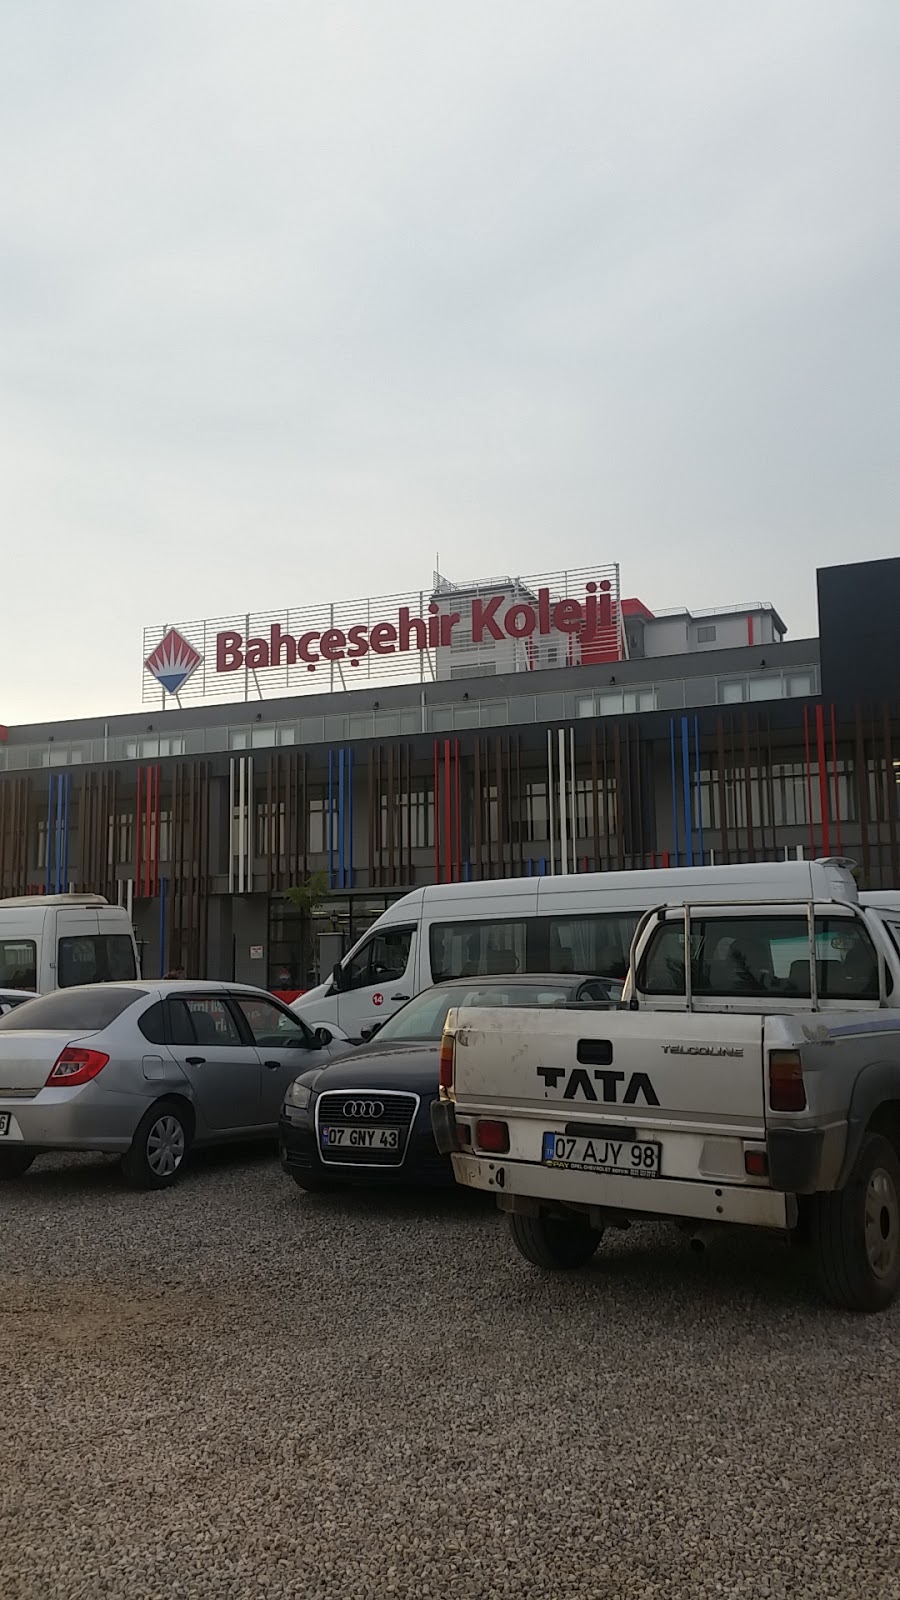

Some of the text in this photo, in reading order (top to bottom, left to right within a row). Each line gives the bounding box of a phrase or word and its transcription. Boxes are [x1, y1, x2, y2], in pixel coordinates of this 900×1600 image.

[216, 580, 612, 672] Bahçeşehir Koleji
[661, 1044, 744, 1058] TELCOLINE
[536, 1066, 661, 1107] TATA
[329, 1129, 345, 1145] 07
[349, 1130, 376, 1146] GNY
[380, 1131, 398, 1148] 43
[555, 1138, 655, 1168] 07 AJY 98
